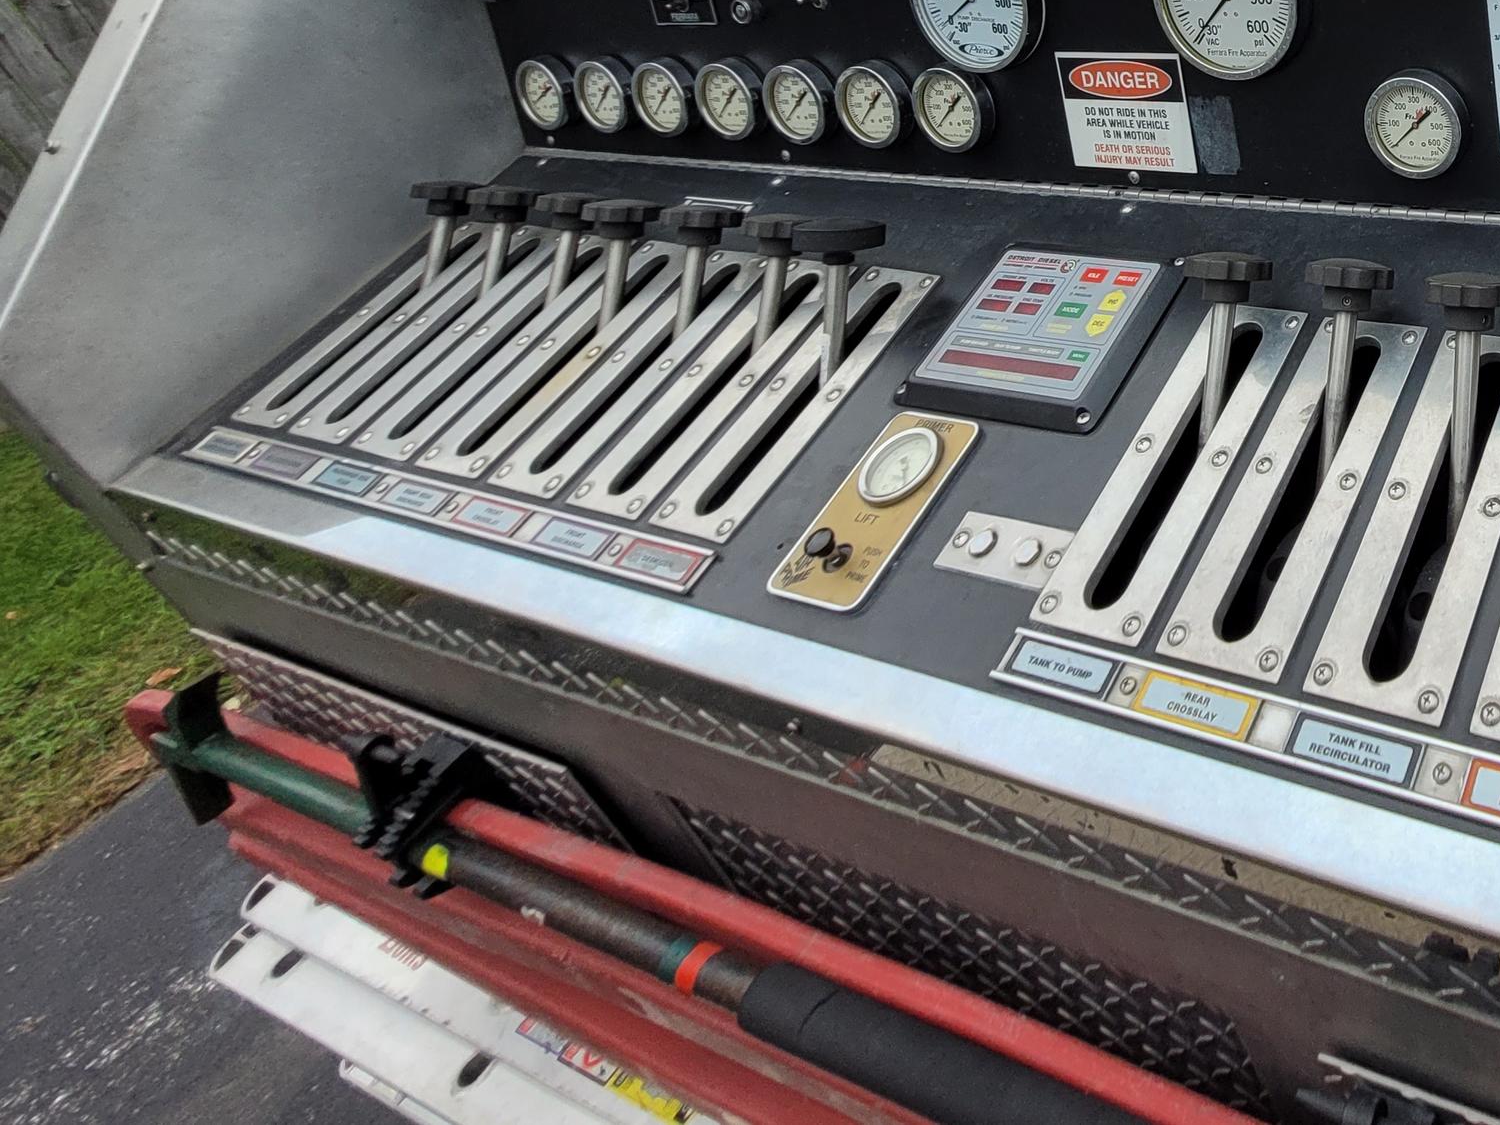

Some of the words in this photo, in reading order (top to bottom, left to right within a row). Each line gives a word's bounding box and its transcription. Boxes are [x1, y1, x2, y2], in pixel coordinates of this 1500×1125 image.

[992, 23, 1008, 34] 600
[1247, 20, 1269, 33] 600
[1206, 38, 1220, 46] VAC
[1254, 38, 1264, 47] psi
[969, 44, 994, 55] Pierce
[1240, 50, 1267, 58] Apparatus
[1081, 71, 1159, 89] DANGER
[1085, 107, 1096, 115] DO
[1100, 107, 1114, 116] NOT
[1116, 108, 1135, 117] RIDE
[1138, 109, 1146, 117] IN
[1149, 109, 1167, 118] THIS
[1086, 119, 1106, 127] AREA
[1108, 119, 1134, 128] WHILE
[1136, 120, 1170, 130] VEHICLE
[1103, 130, 1111, 138] IS
[1114, 130, 1122, 139] IN
[1124, 131, 1156, 141] MOTION
[1095, 144, 1119, 153] DEATH
[1122, 145, 1133, 154] OR
[1136, 146, 1170, 155] SERIOUS
[1095, 155, 1122, 164] INJURY
[1125, 156, 1142, 165] MAY
[1145, 157, 1174, 167] RESULT
[915, 419, 954, 433] PRIMER
[854, 512, 880, 525] LIFT
[1028, 655, 1051, 669] TANK
[1053, 662, 1065, 673] TO
[1066, 665, 1093, 681] PUMP
[1184, 691, 1210, 707] REAR
[1167, 702, 1218, 723] CROSSLAY
[1328, 733, 1356, 750] TANK
[1358, 741, 1382, 756] FILL
[1309, 743, 1390, 774] RECIRCULATOR
